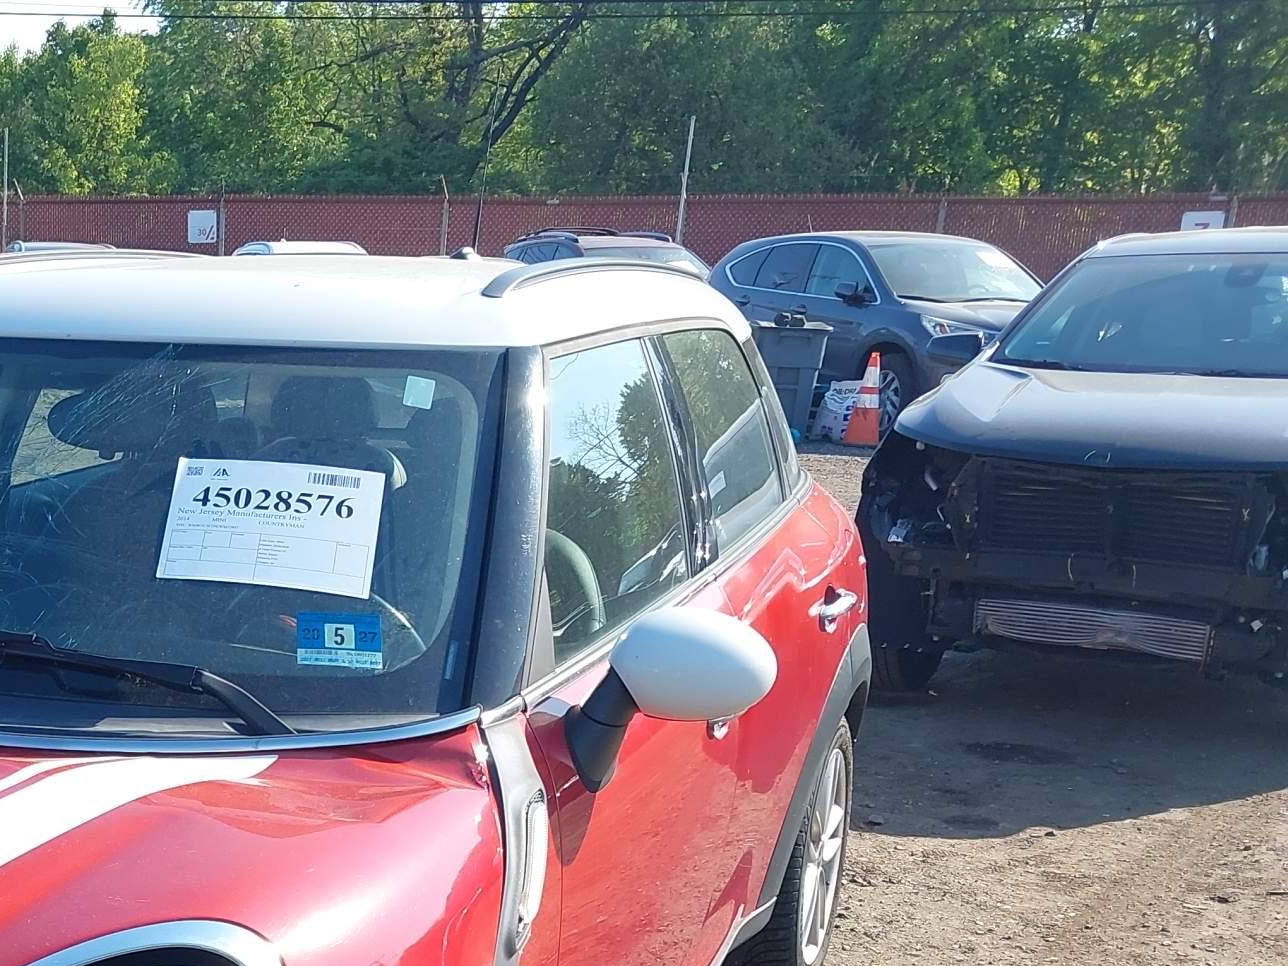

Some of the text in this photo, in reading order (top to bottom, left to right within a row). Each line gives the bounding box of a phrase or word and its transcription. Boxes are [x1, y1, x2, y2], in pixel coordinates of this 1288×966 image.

[192, 485, 354, 519] 45028576
[177, 507, 196, 515] New
[199, 508, 225, 516] Jersey
[227, 509, 287, 520] Manufacturers
[333, 627, 345, 646] 5
[358, 631, 378, 643] 27
